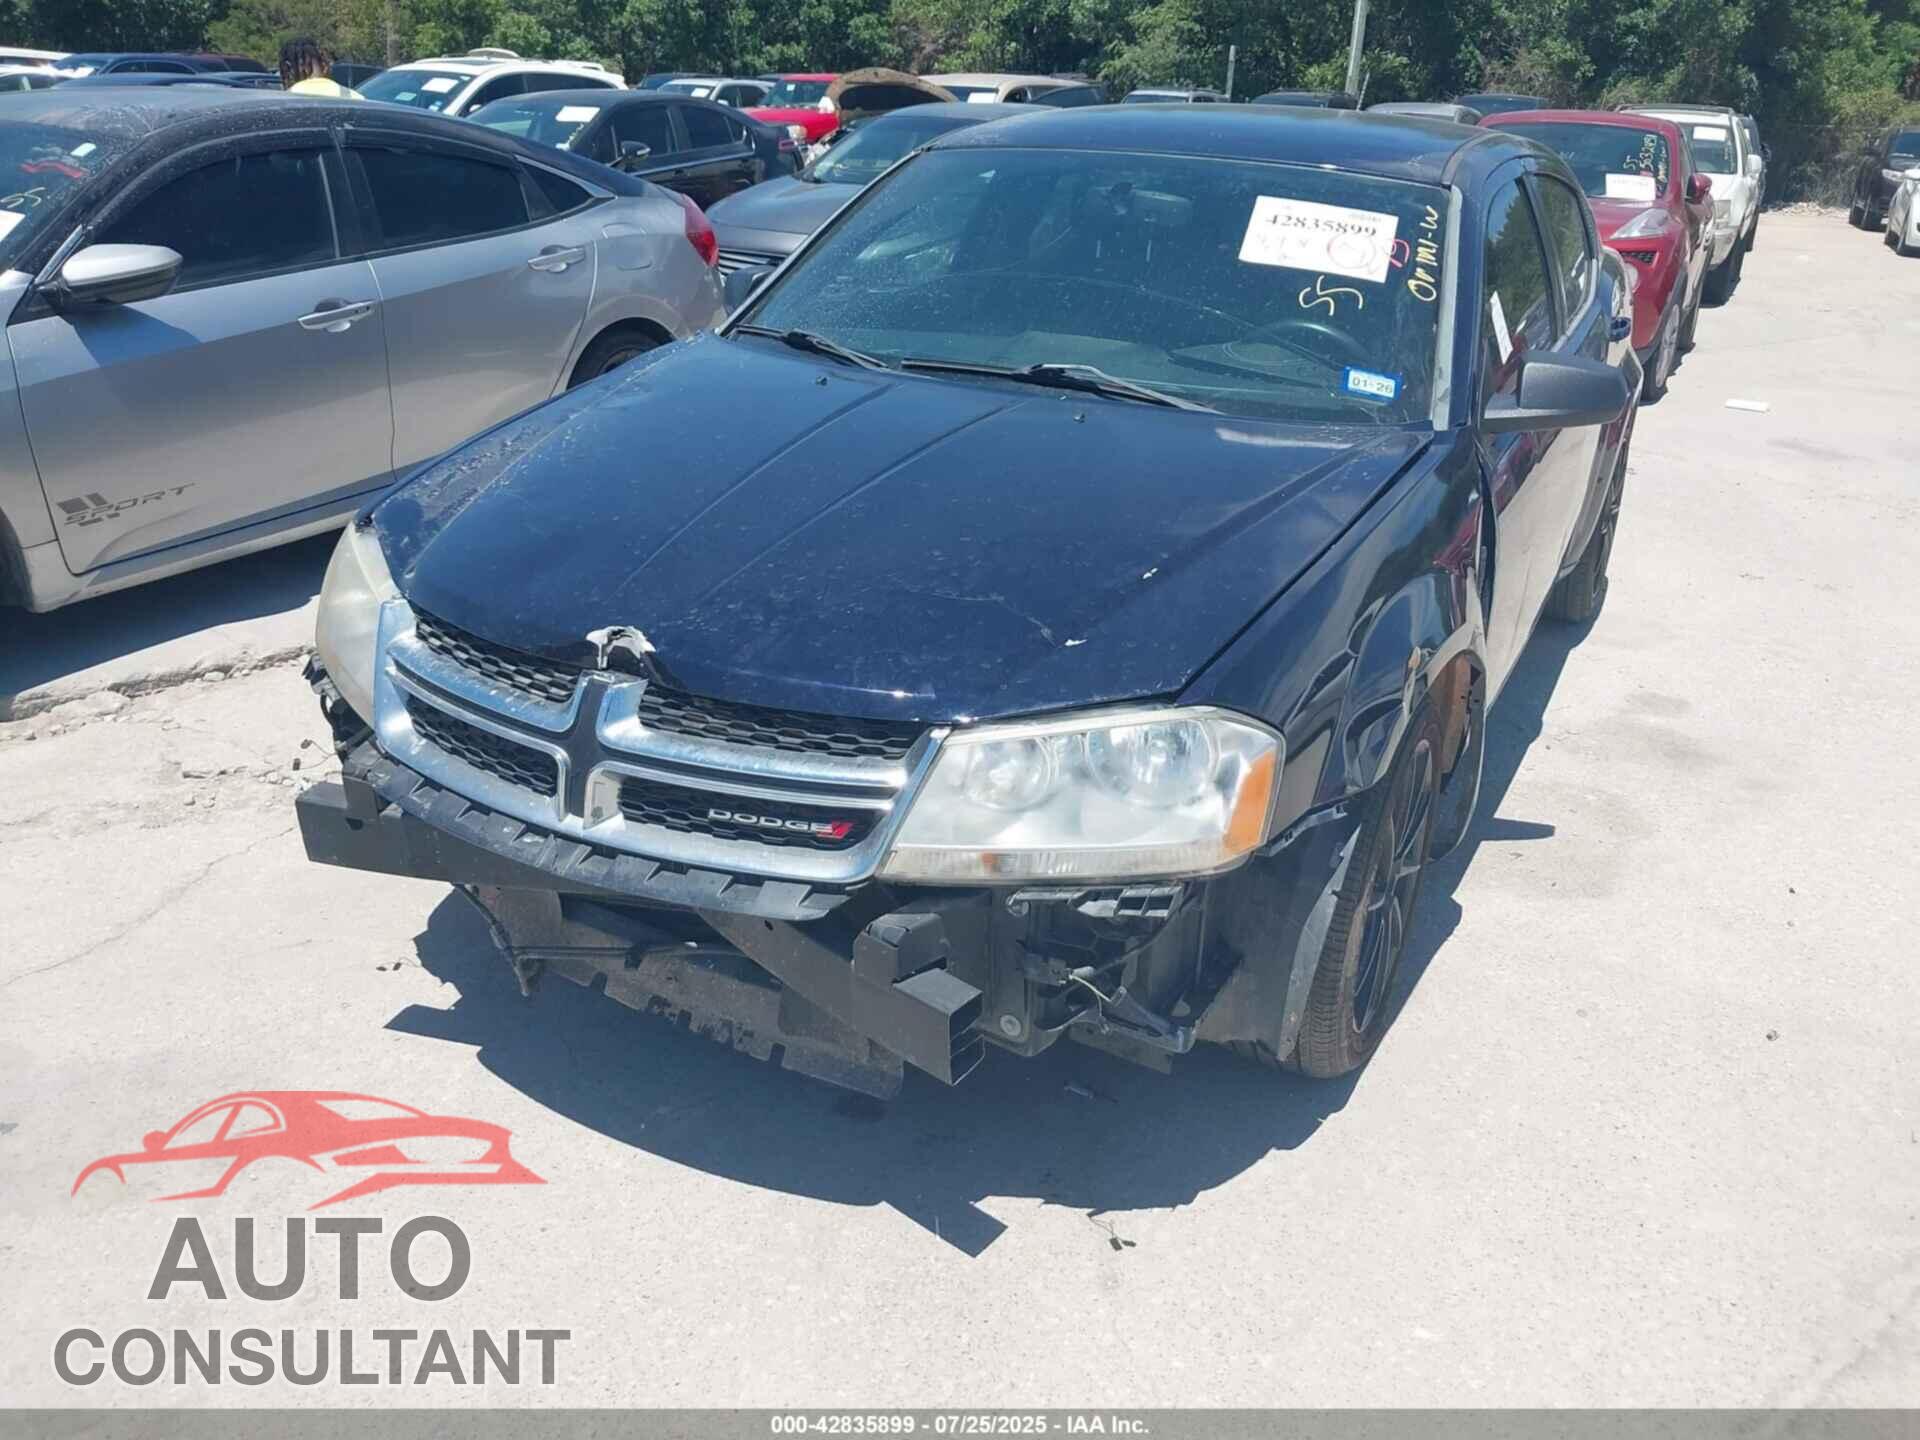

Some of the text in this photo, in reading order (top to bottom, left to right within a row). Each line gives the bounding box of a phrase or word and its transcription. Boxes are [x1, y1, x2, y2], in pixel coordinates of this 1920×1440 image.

[1265, 213, 1377, 237] 42835899
[1351, 376, 1394, 394] 01-26
[64, 483, 195, 526] SPORT
[707, 808, 833, 834] DODGE
